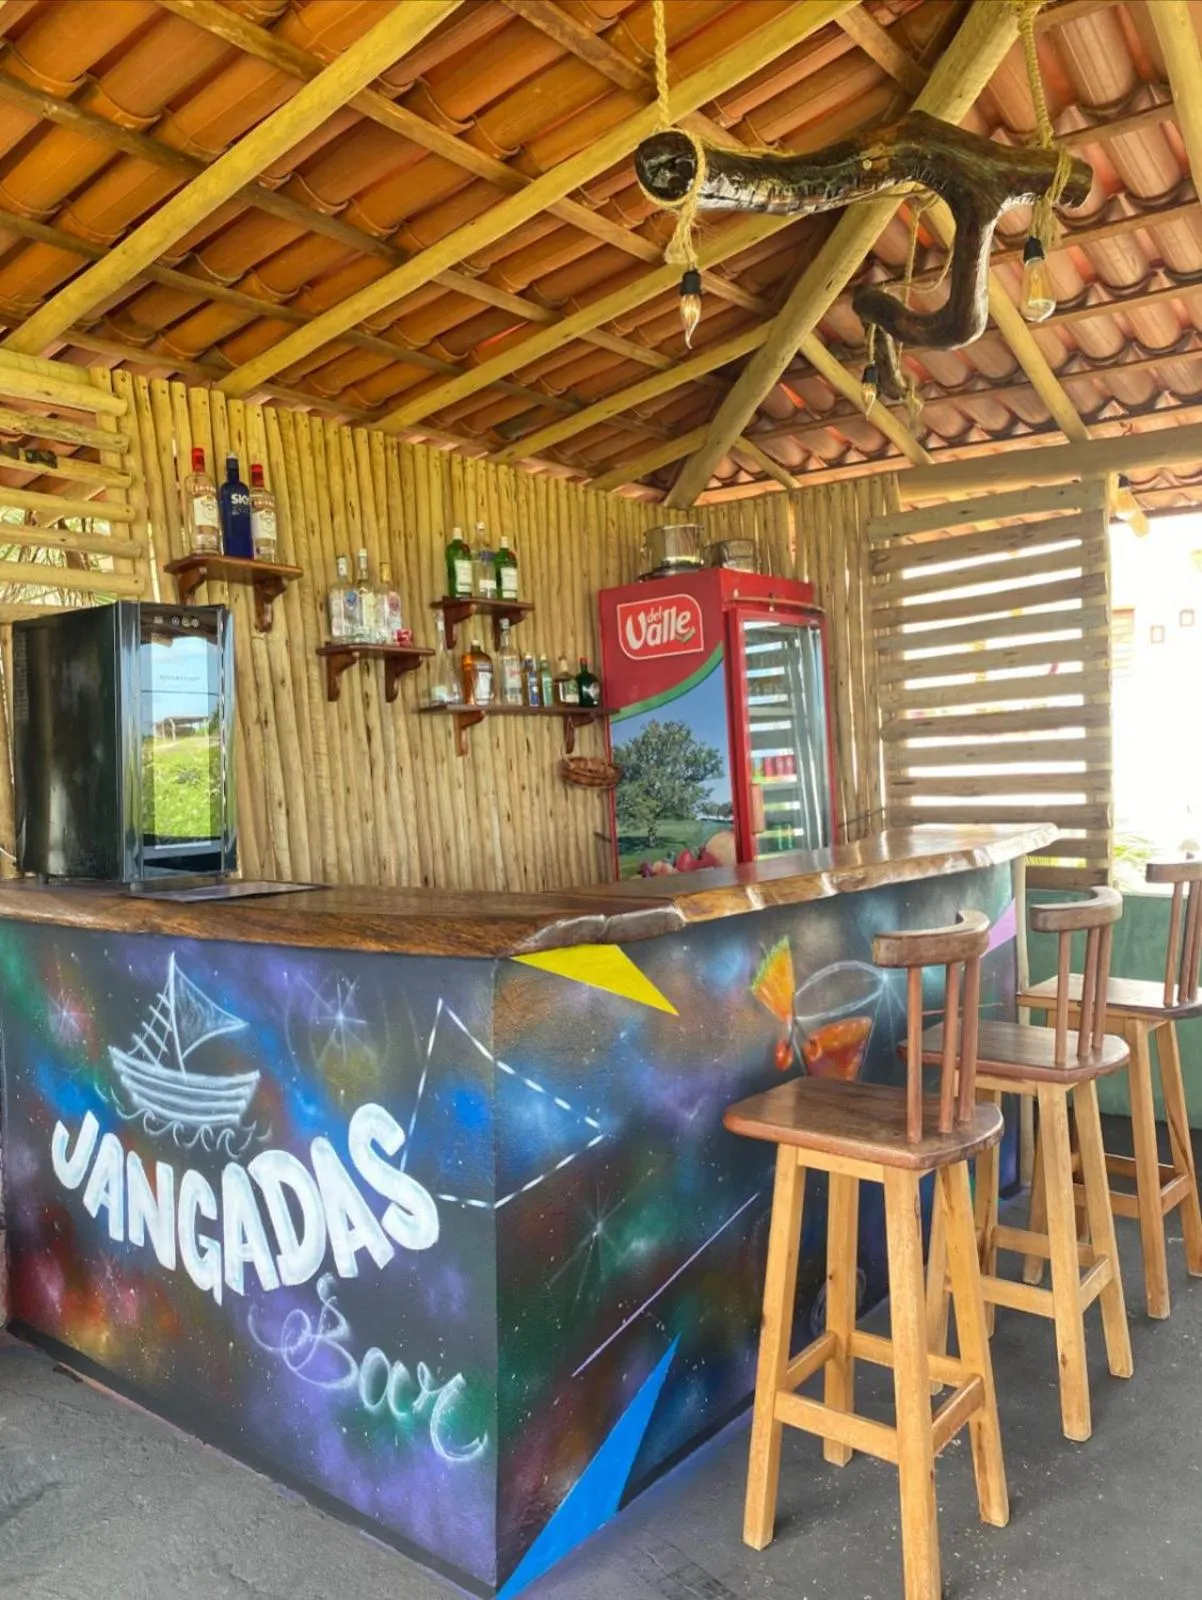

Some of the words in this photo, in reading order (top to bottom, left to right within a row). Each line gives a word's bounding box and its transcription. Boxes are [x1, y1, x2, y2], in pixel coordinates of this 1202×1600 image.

[625, 606, 692, 650] Valle
[647, 605, 663, 623] del
[51, 1103, 440, 1304] JANGADAS
